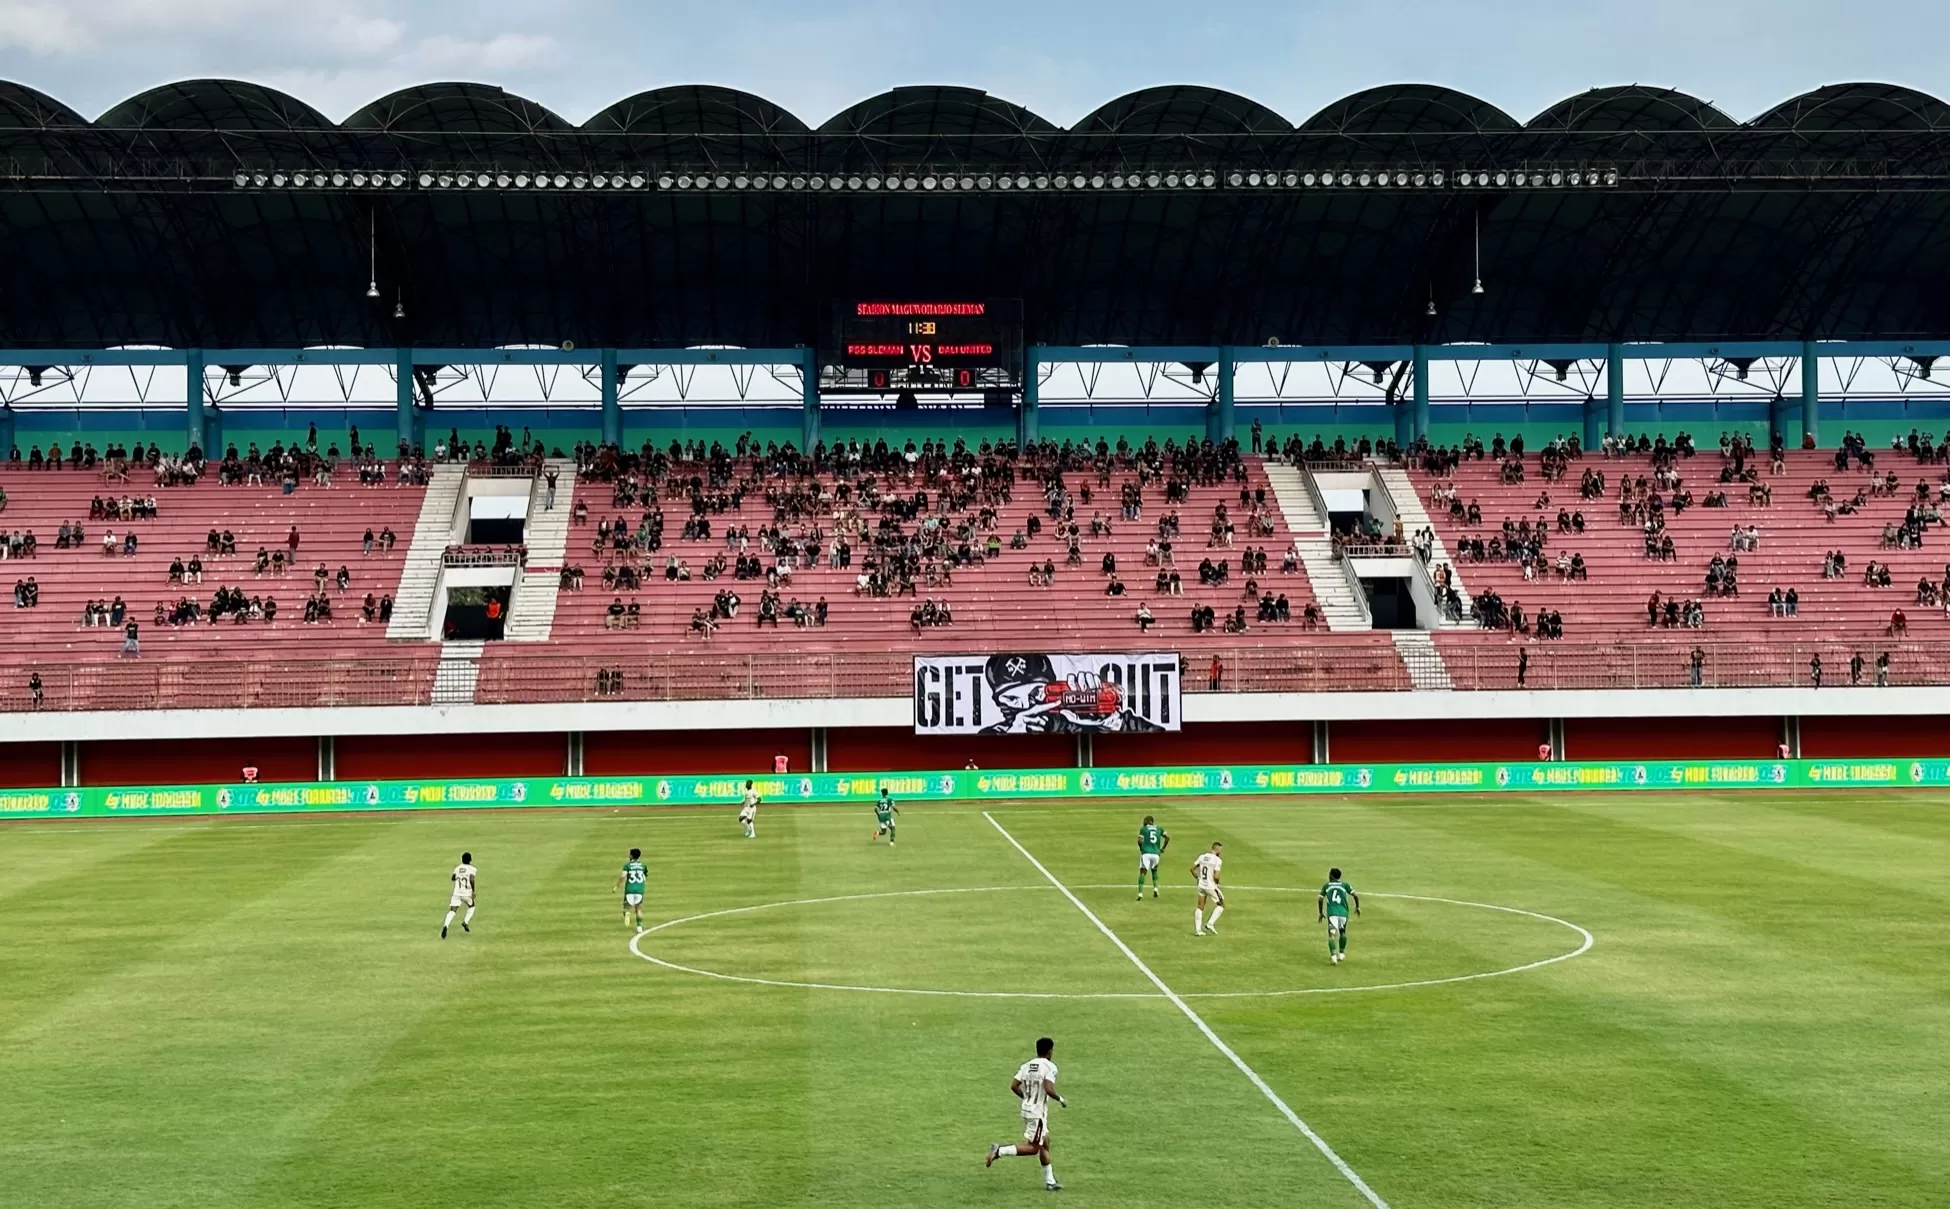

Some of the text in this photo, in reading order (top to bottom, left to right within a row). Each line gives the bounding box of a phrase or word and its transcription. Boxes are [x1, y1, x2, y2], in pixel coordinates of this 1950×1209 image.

[910, 344, 932, 363] VS
[874, 372, 885, 387] 0
[959, 370, 970, 386] 0
[917, 664, 984, 727] GET
[1149, 830, 1158, 844] 5
[628, 870, 644, 884] 33
[1202, 865, 1208, 880] 9
[1331, 889, 1342, 905] 4
